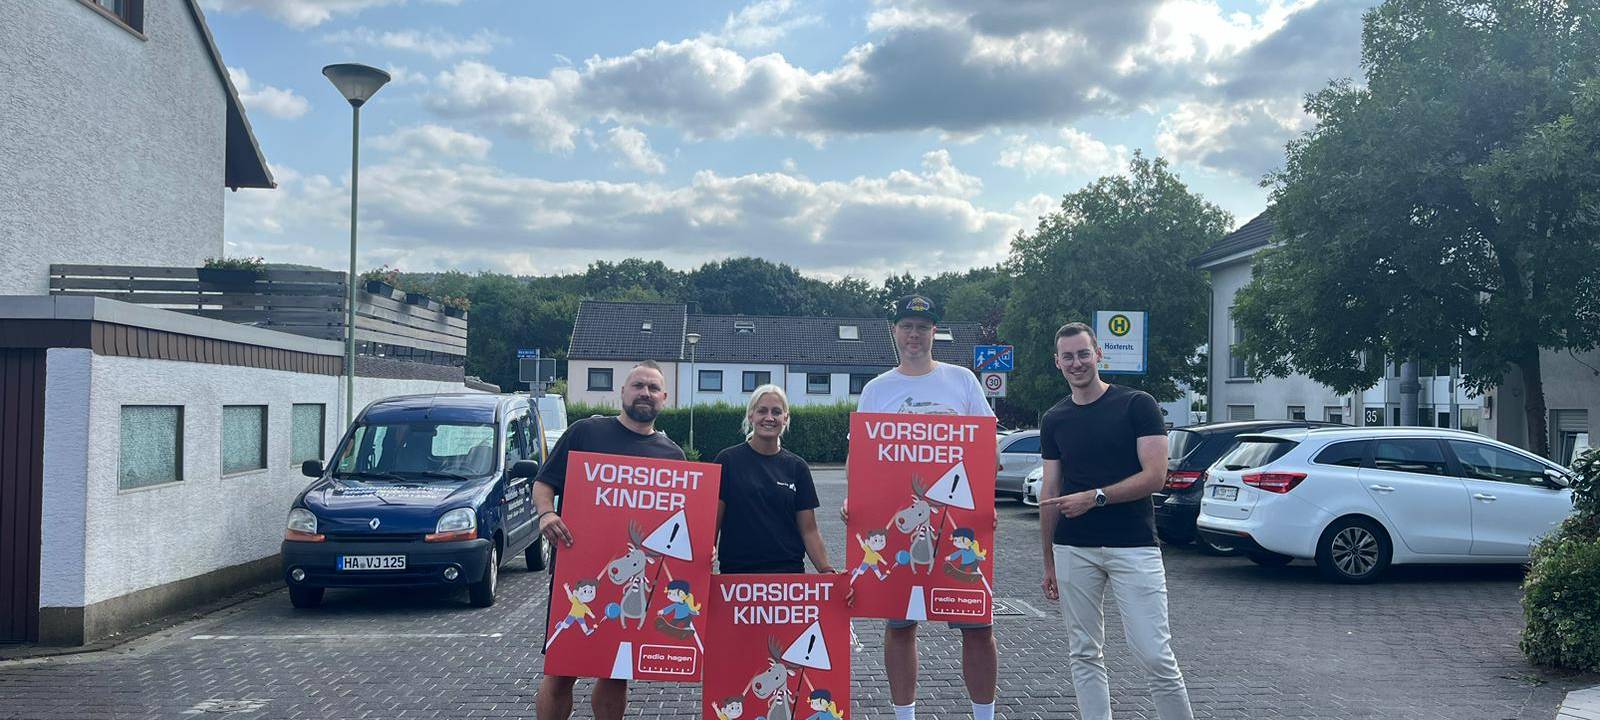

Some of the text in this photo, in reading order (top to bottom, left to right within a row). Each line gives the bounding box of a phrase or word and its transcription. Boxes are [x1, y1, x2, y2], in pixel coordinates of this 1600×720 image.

[989, 378, 999, 387] 30
[1366, 410, 1378, 423] 35
[864, 421, 979, 442] VORSICHT
[878, 443, 964, 463] KINDER
[584, 461, 704, 490] VORSICHT
[595, 486, 687, 511] KINDER
[344, 557, 405, 569] HA VJ 125
[720, 582, 834, 602] VORSICHT
[957, 597, 982, 605] hagen
[733, 605, 819, 624] KINDER
[667, 654, 693, 663] hagen
